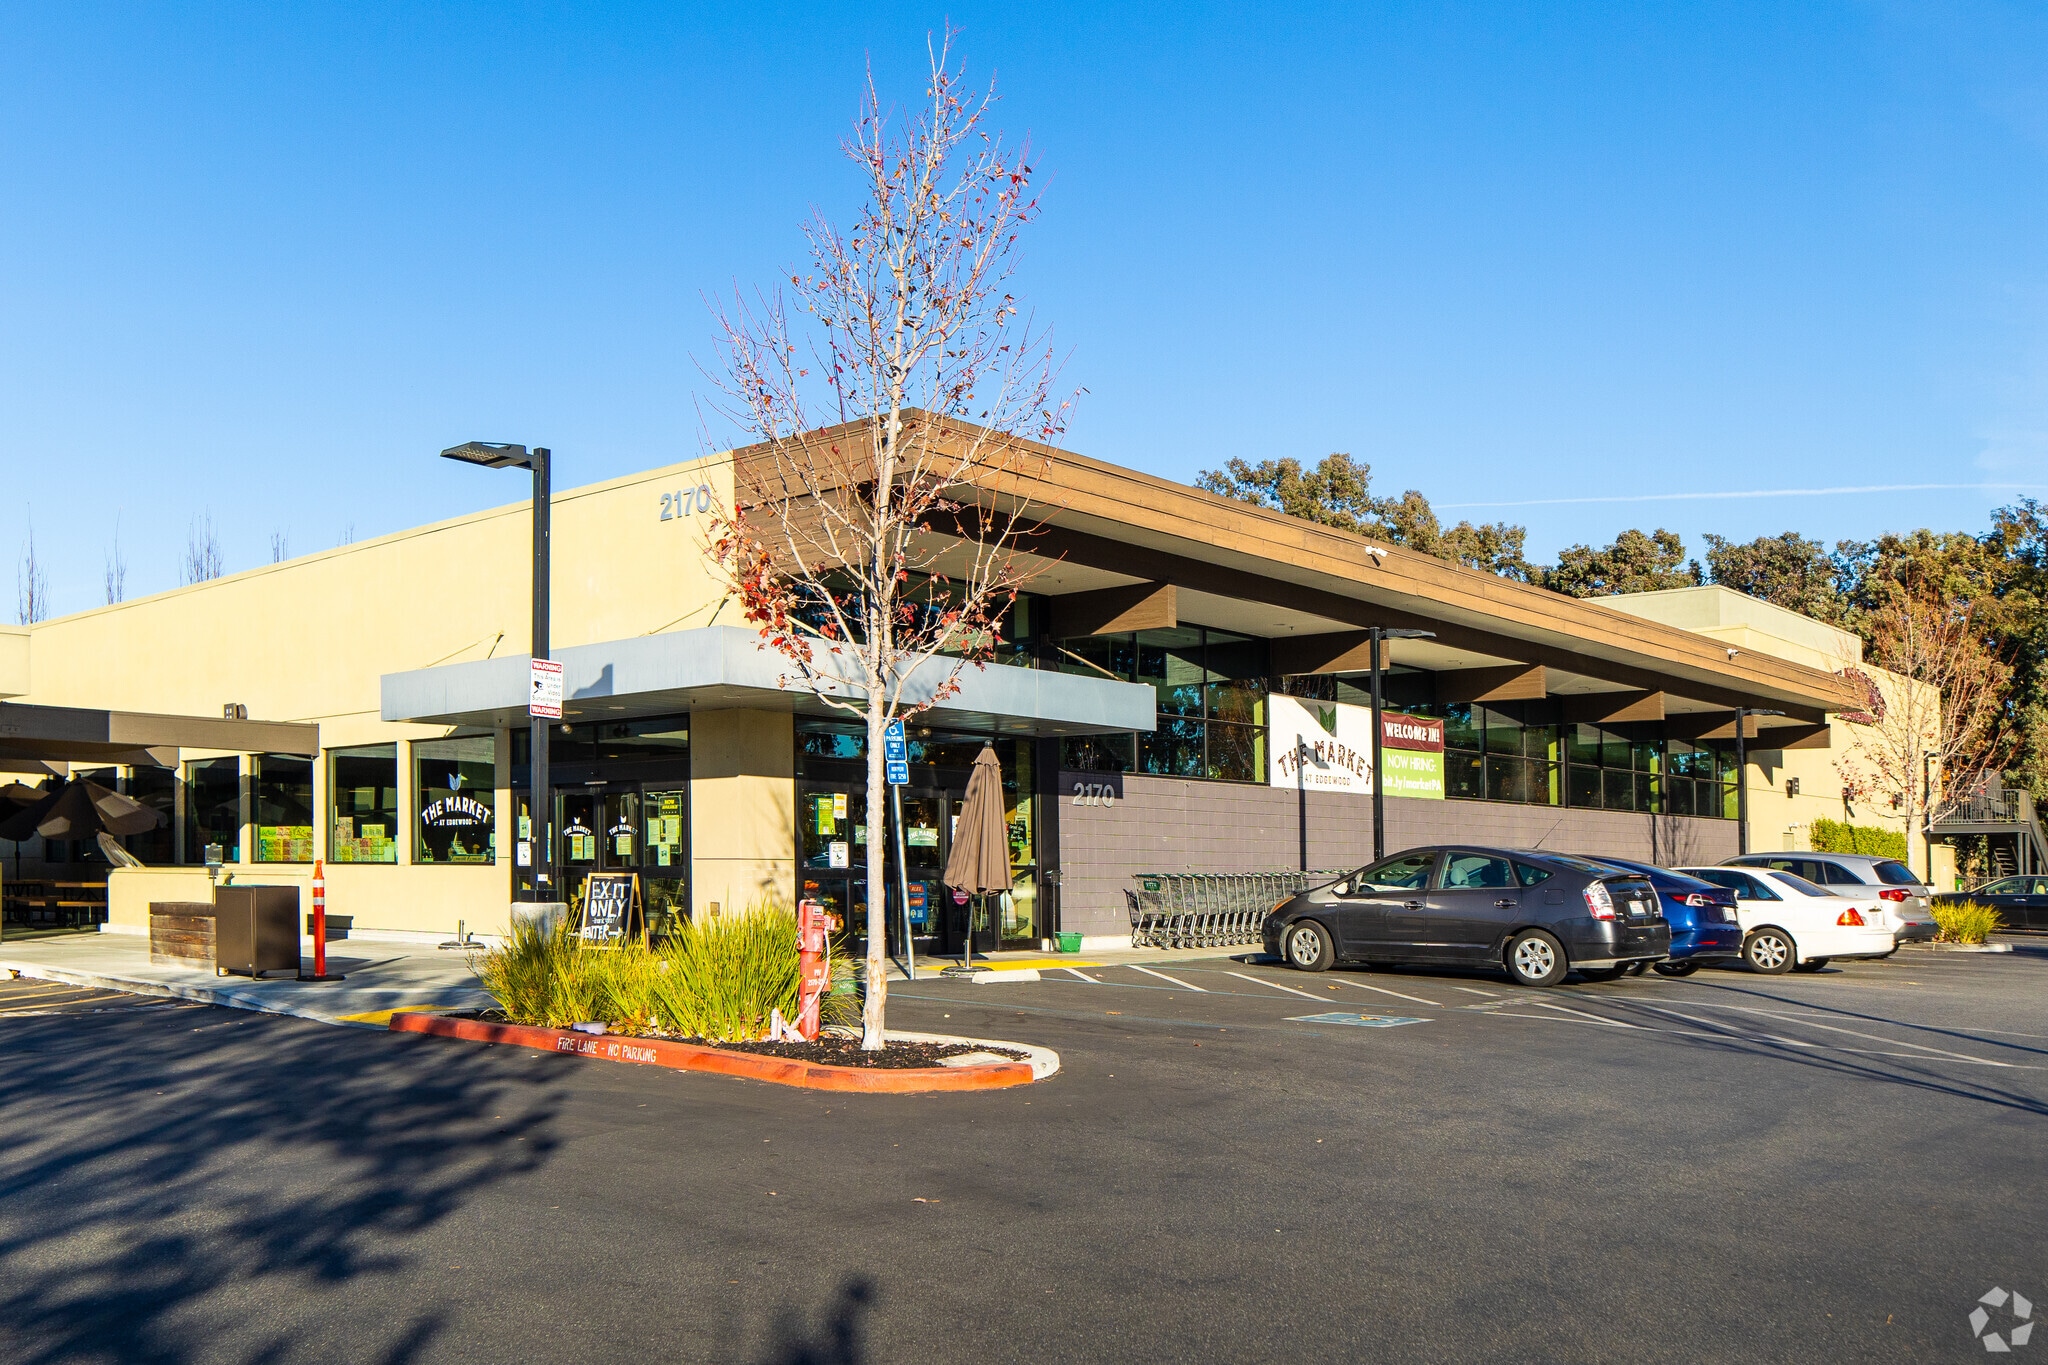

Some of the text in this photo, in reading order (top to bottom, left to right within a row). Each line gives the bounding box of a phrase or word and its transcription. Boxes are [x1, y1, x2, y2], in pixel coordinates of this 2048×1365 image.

[660, 485, 710, 521] 2170
[532, 662, 561, 672] WARNING
[545, 672, 555, 681] Area
[531, 706, 560, 716] WARNING
[1384, 722, 1440, 743] WELCOME IN!
[1278, 740, 1374, 785] THE MARKET
[1387, 754, 1437, 772] NOW HIRING:
[1305, 773, 1351, 786] AT EDGEWOOD
[1072, 782, 1115, 808] 2170
[421, 796, 491, 825] THE MARKET
[446, 818, 473, 826] EDGEWOOD
[608, 825, 618, 836] THE
[619, 824, 638, 836] MARKET
[563, 825, 592, 836] THE MARKET
[908, 831, 918, 840] THE
[918, 830, 939, 840] MARKET
[592, 881, 630, 899] EXIT
[590, 898, 628, 918] ONLY
[583, 925, 610, 940] ENTER
[557, 1037, 575, 1051] FIRE
[577, 1039, 598, 1054] LANE
[607, 1043, 619, 1057] NO
[622, 1045, 657, 1062] PARKING
